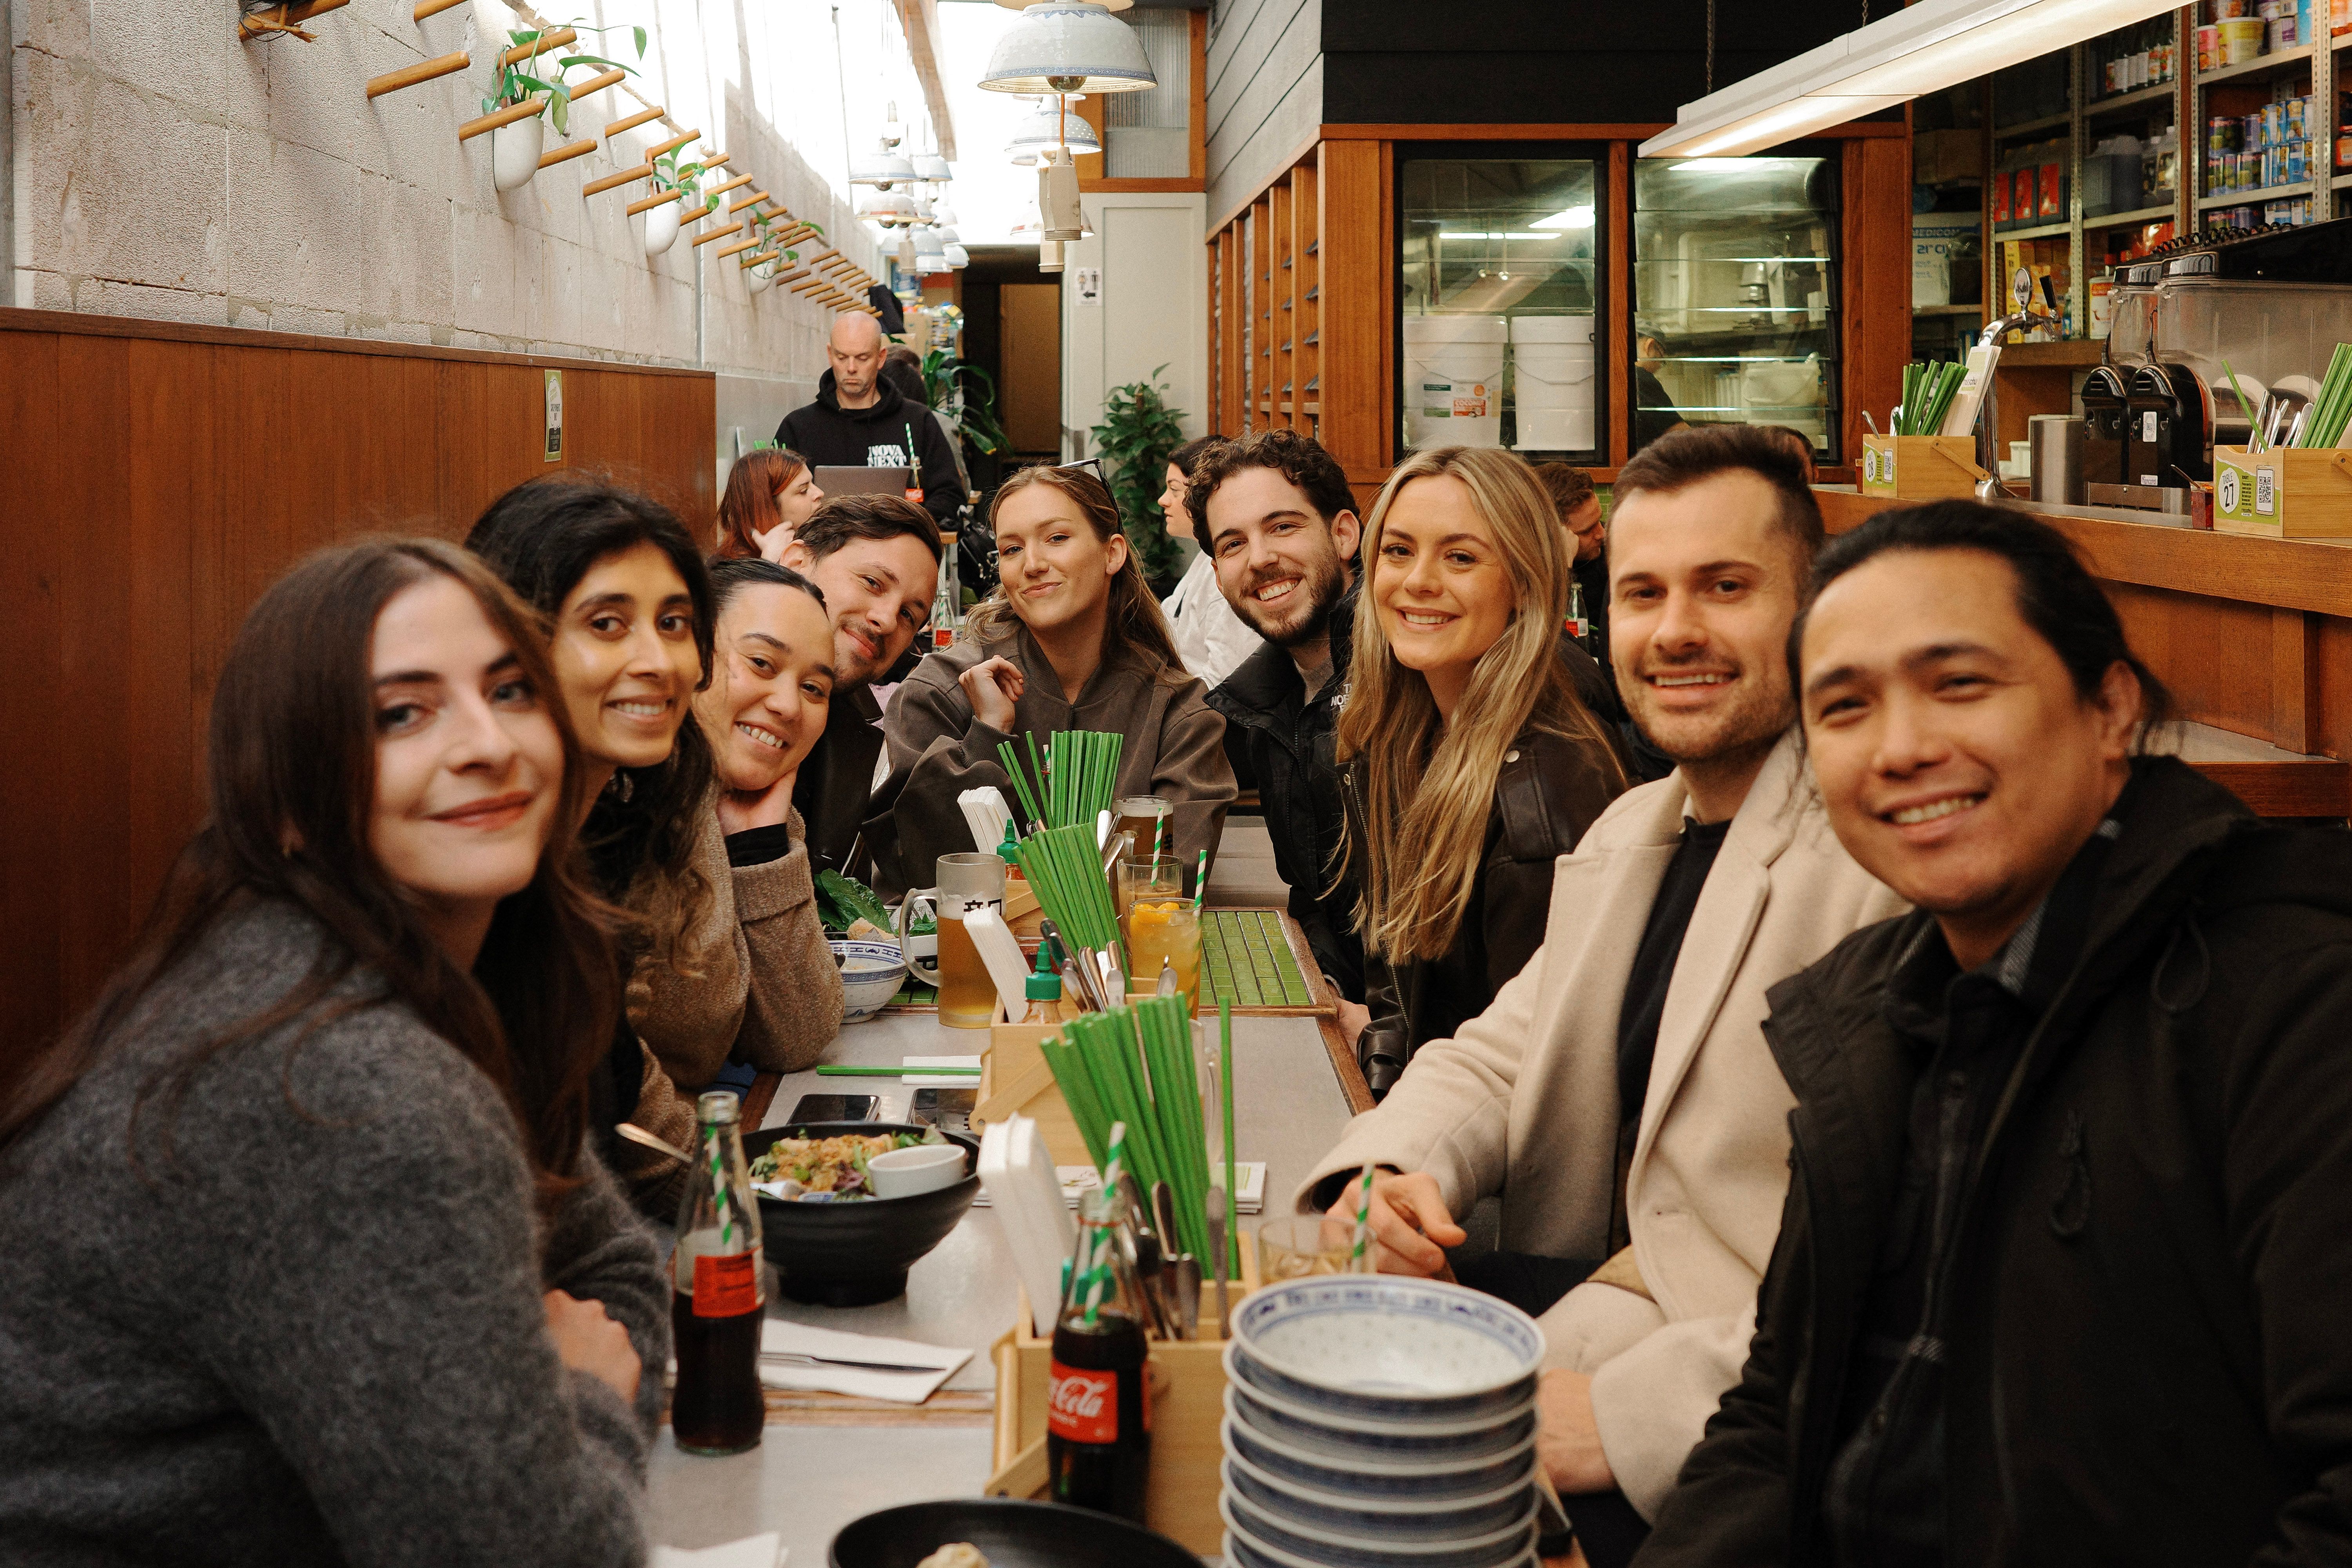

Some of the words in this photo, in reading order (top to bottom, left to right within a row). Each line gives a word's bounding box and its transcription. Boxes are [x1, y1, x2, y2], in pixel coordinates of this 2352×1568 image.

[868, 445, 904, 456] NOVA
[867, 455, 907, 468] NEXT
[1868, 461, 1873, 478] 28
[2222, 472, 2233, 485] TABLE
[2224, 483, 2234, 508] 27
